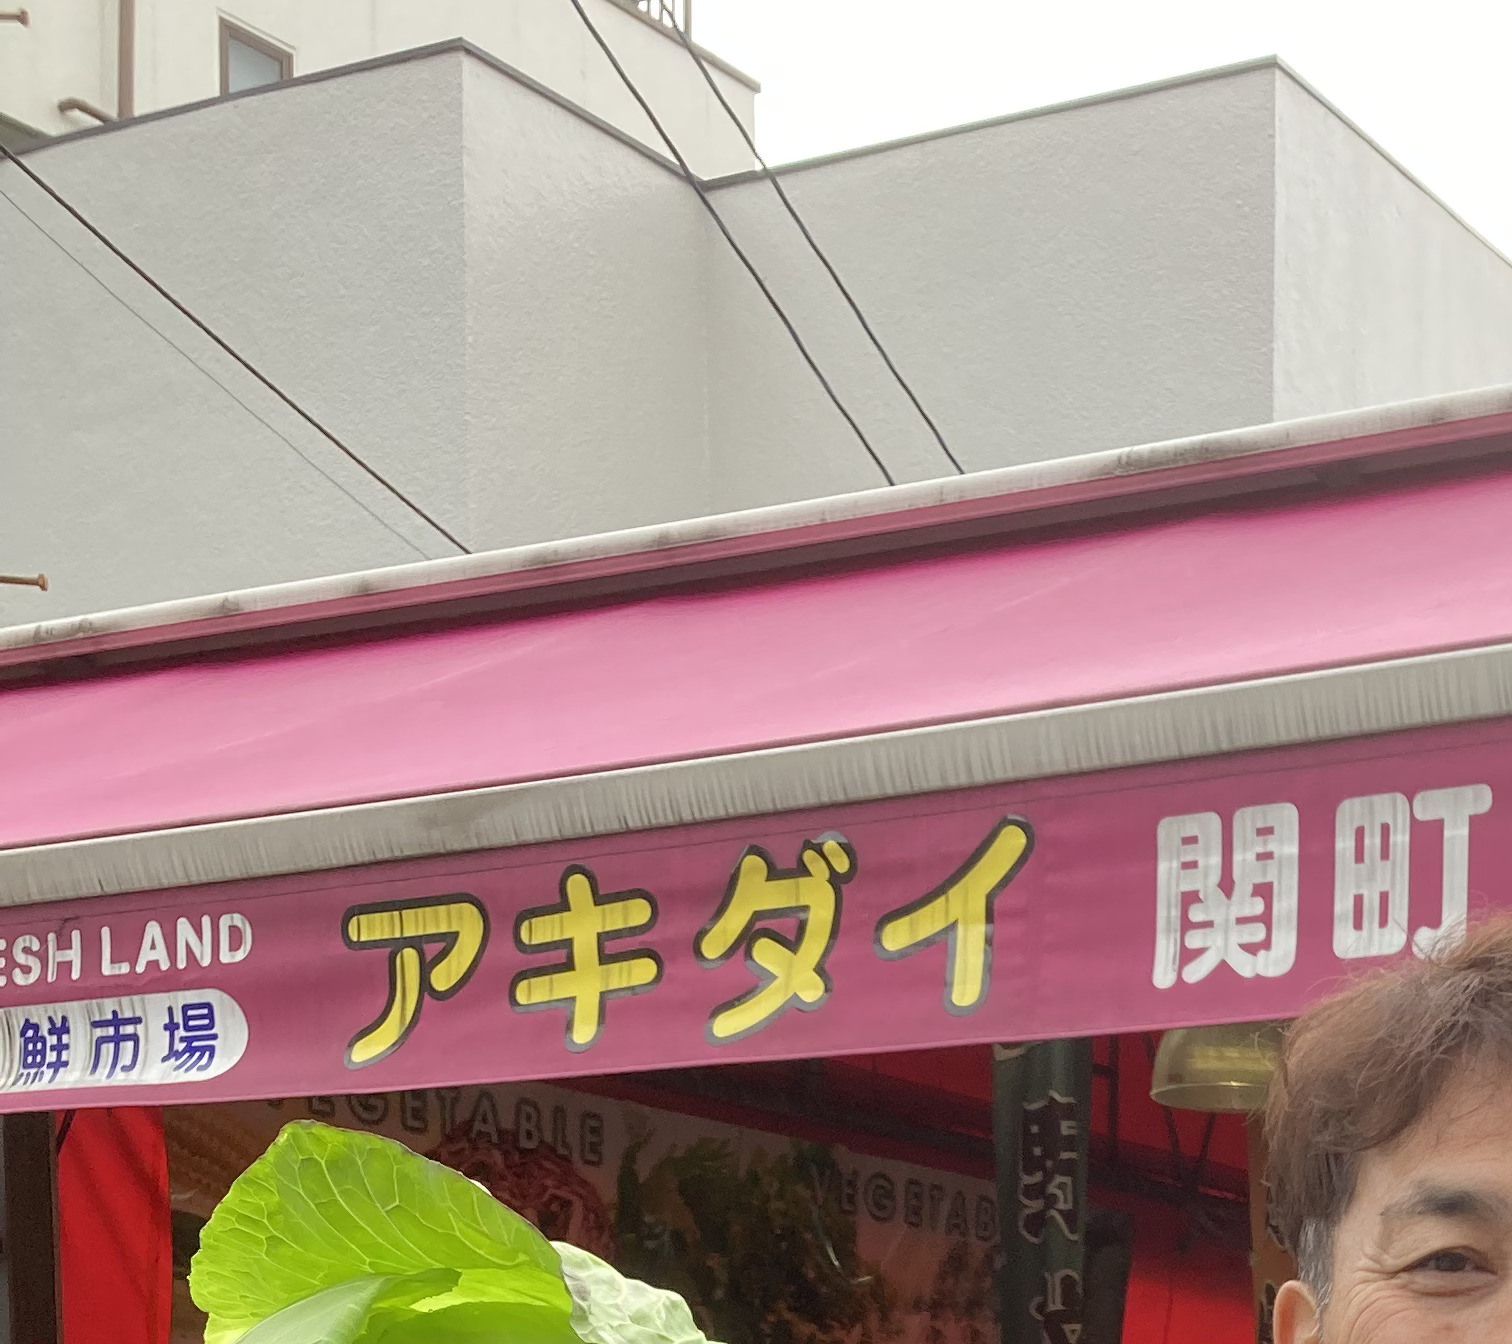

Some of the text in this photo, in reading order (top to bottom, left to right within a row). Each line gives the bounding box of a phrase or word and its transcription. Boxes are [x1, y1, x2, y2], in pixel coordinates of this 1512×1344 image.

[102, 912, 254, 977] LAND
[342, 814, 1036, 1070] アキダイ
[12, 1001, 220, 1086] 鮮市場
